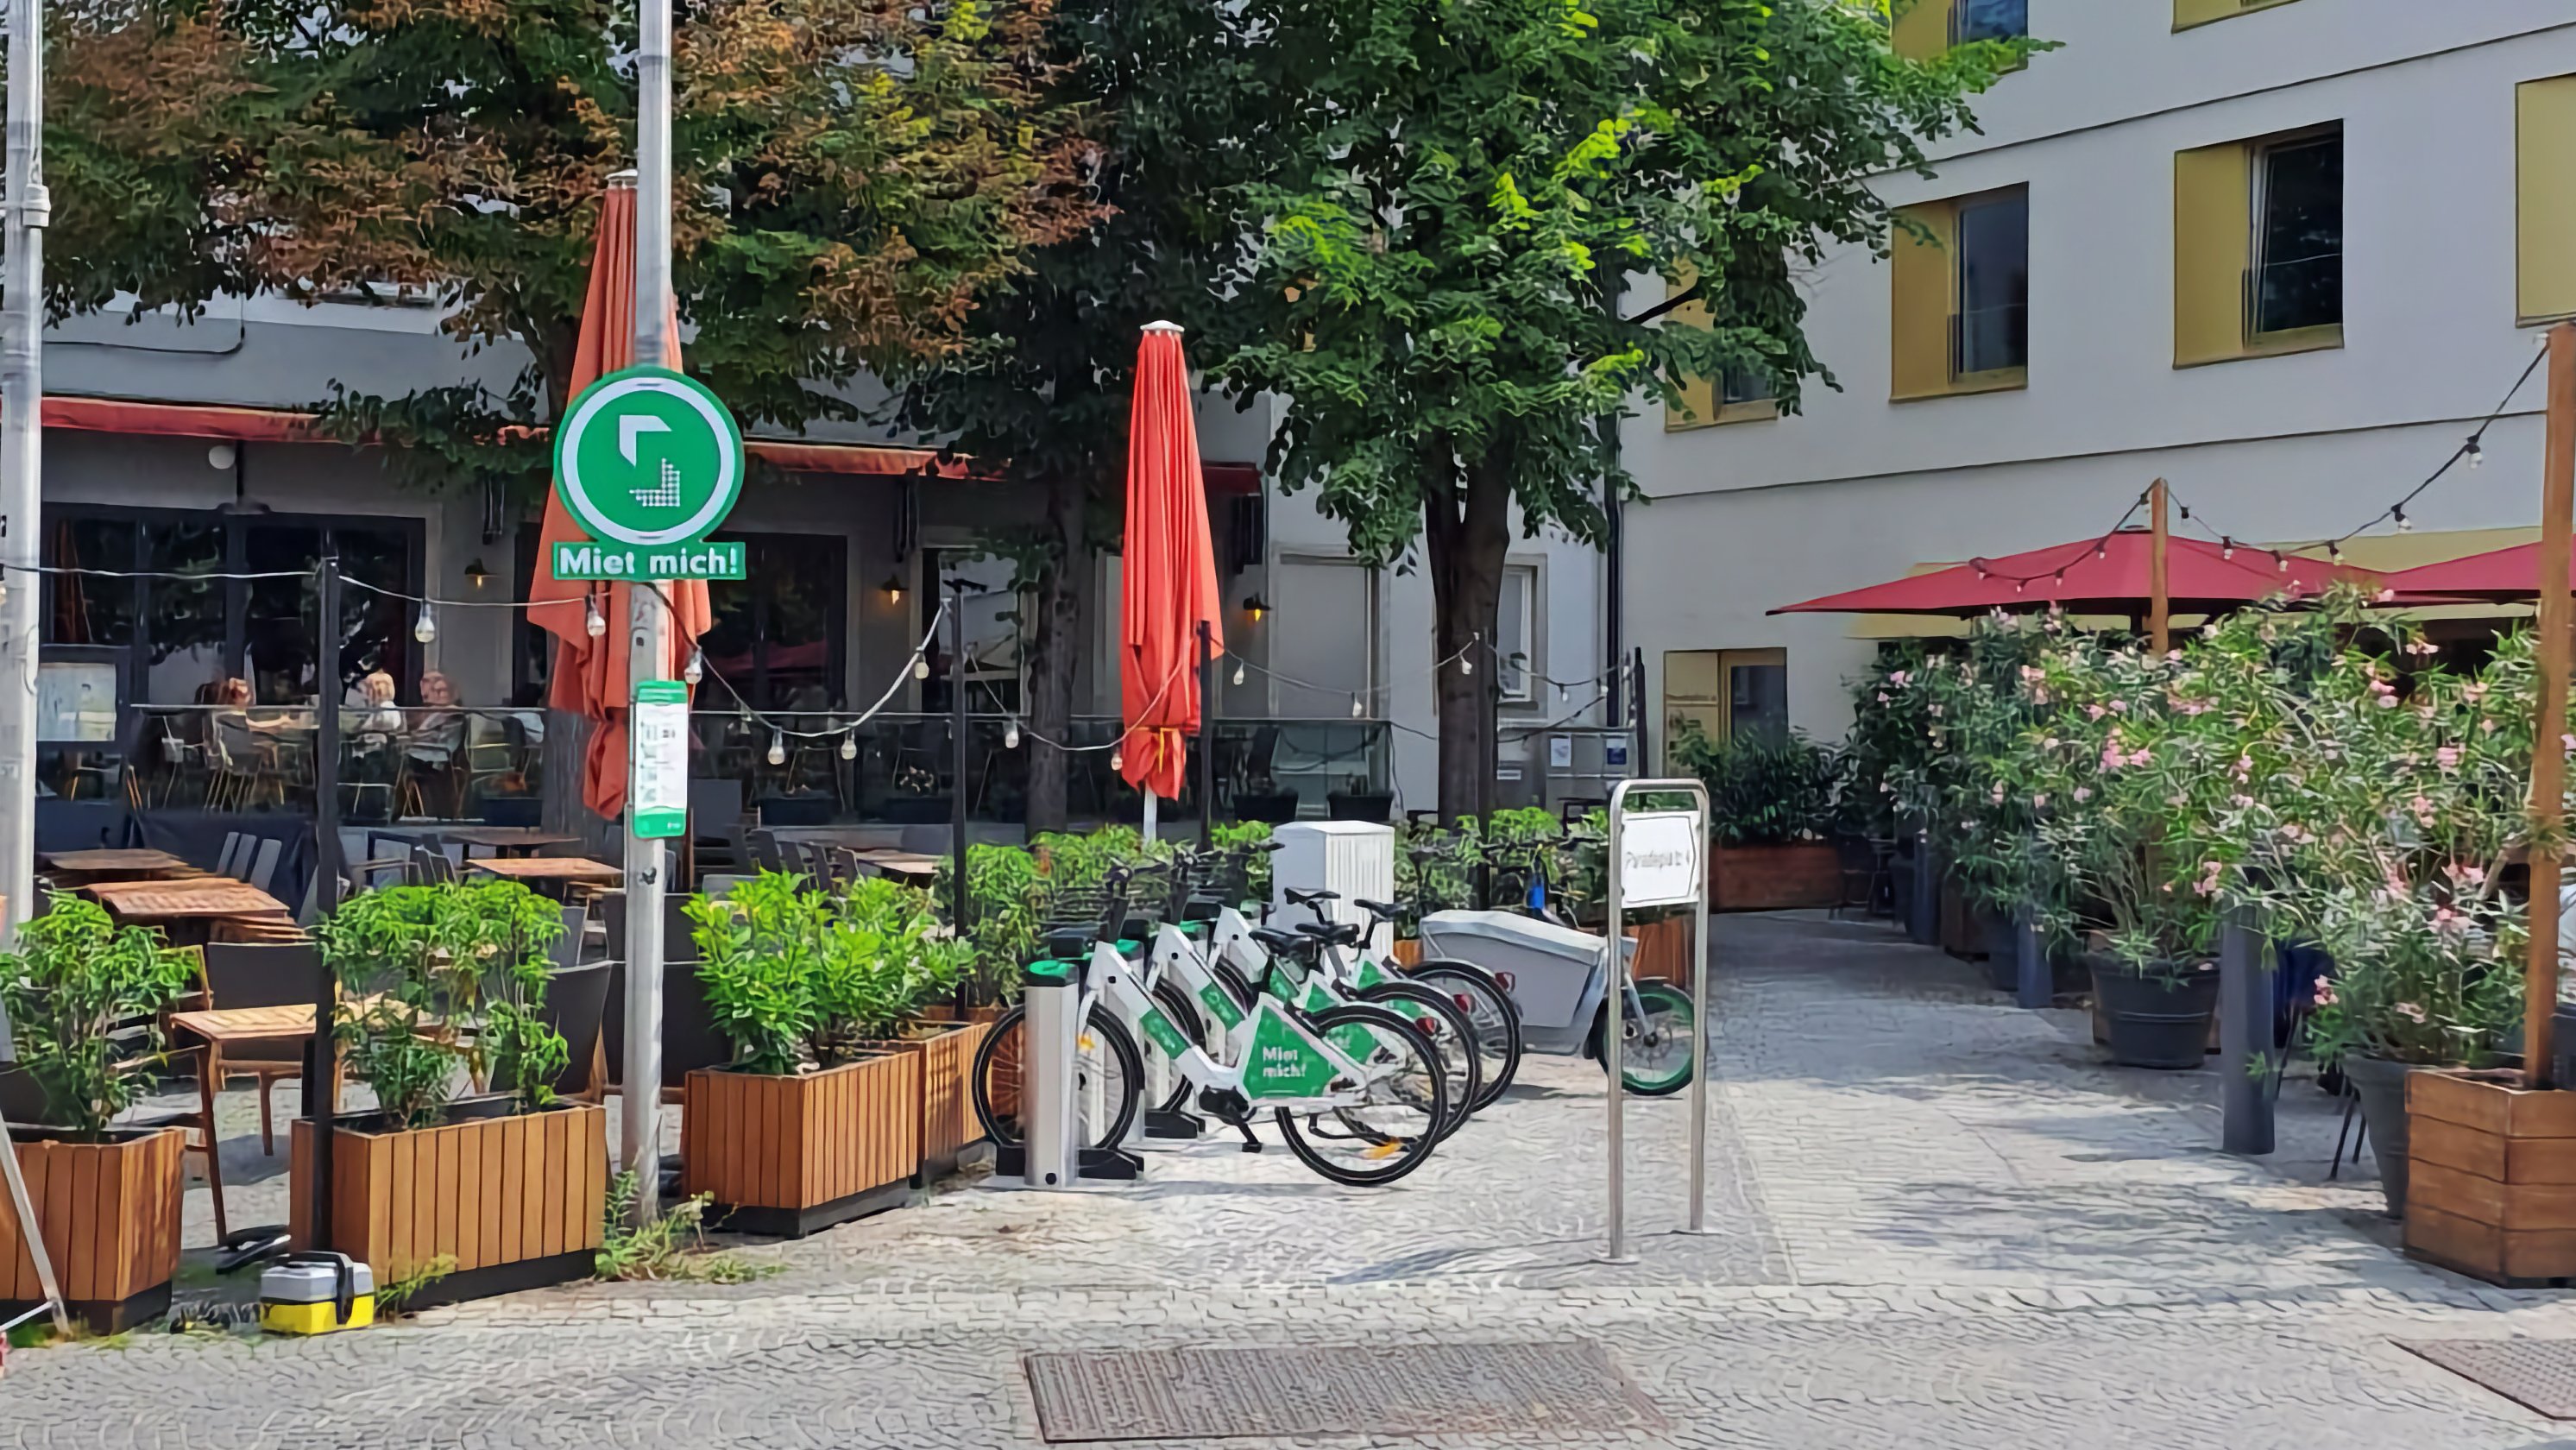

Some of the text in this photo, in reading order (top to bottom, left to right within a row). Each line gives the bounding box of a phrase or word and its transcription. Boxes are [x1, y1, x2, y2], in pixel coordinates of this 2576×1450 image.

[560, 547, 738, 575] Miet mich!
[1263, 1062, 1307, 1077] mich!
